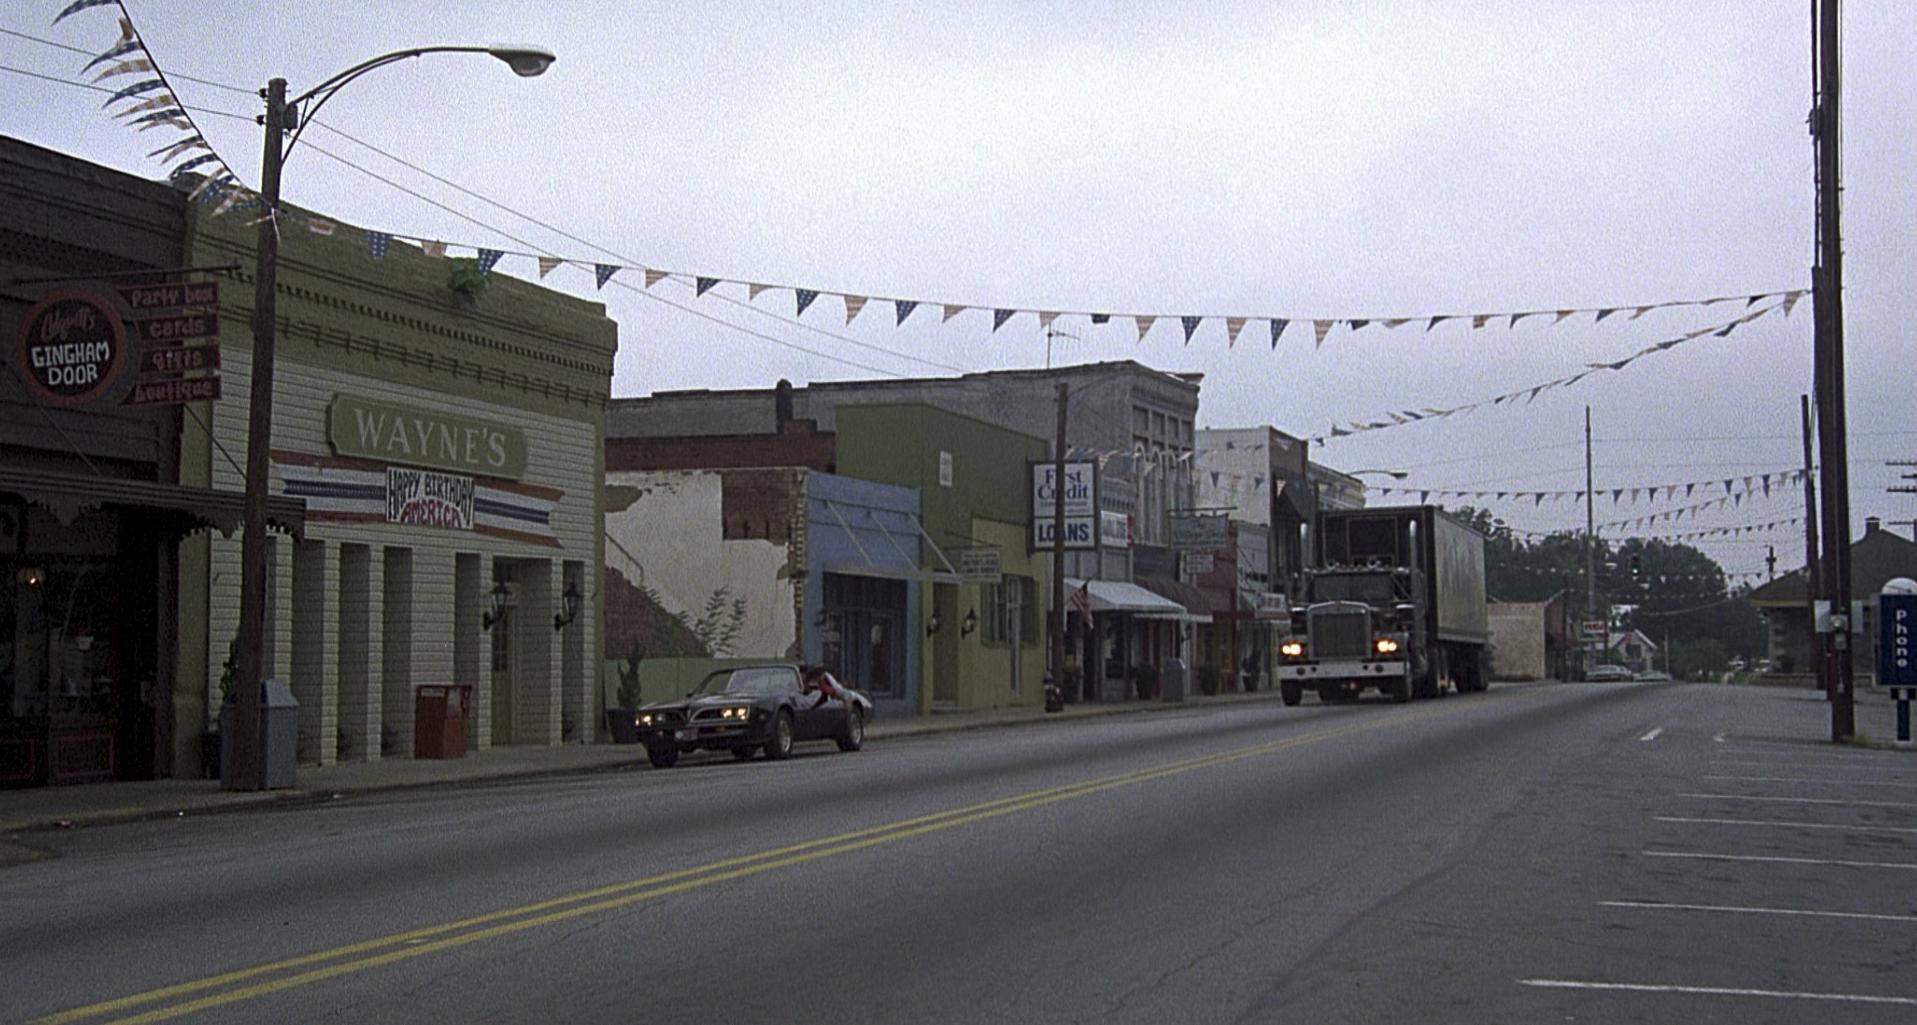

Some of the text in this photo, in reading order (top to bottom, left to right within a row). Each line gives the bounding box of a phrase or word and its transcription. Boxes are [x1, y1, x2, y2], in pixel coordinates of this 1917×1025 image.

[31, 341, 110, 368] GINGHAM
[48, 364, 98, 385] DOOR
[354, 408, 506, 467] WAYNE'S
[388, 469, 475, 526] HAPPY BIRTHDAY
[400, 499, 463, 528] AMERICA
[1038, 523, 1090, 543] LONS
